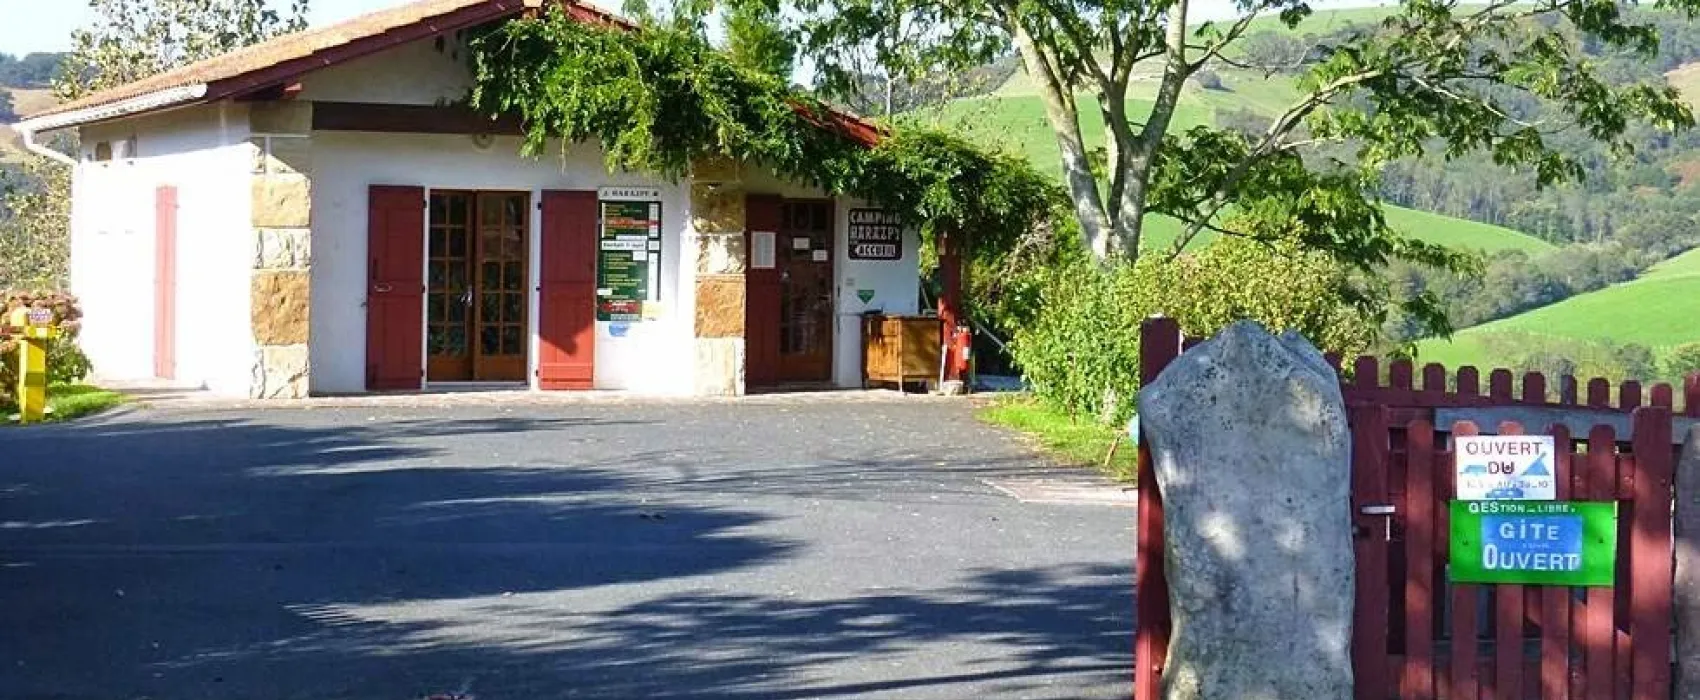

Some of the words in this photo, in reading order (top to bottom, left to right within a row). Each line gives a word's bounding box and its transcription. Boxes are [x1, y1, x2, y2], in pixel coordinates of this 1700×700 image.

[858, 245, 896, 256] ACCUEIL
[1465, 441, 1543, 456] OUVERT
[1487, 461, 1515, 475] DU
[1468, 502, 1526, 514] GESTION
